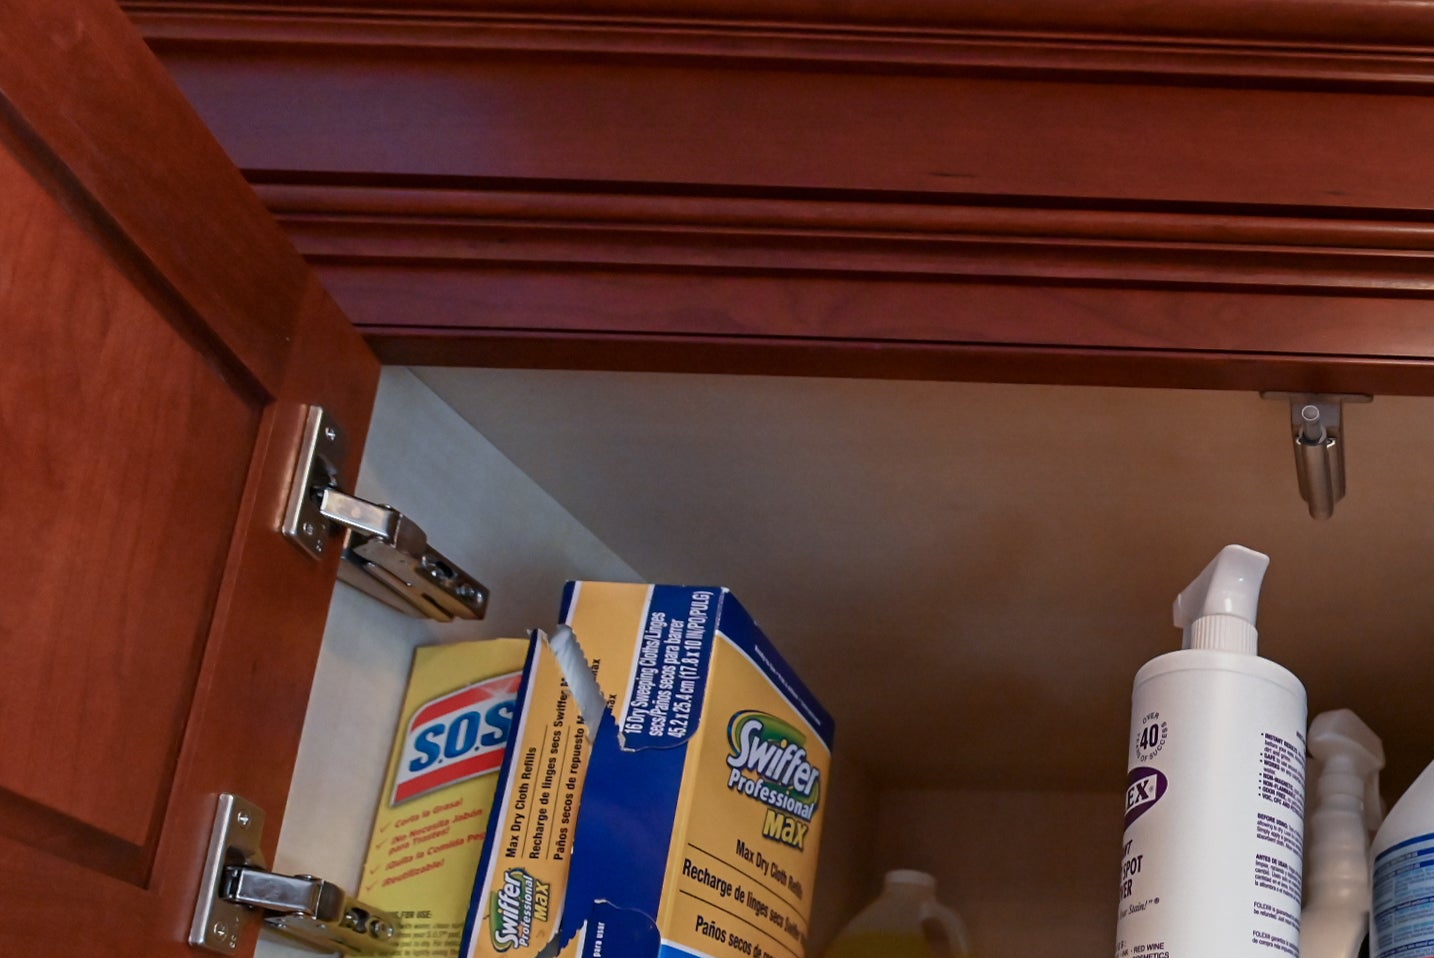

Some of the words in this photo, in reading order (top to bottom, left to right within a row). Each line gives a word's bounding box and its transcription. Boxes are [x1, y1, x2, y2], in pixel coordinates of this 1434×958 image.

[664, 618, 684, 644] barrer
[664, 644, 681, 664] para
[685, 640, 702, 651] 10
[660, 665, 677, 690] secos
[678, 657, 700, 679] (17.8
[630, 668, 658, 708] Sweeping
[680, 679, 695, 694] cm
[554, 689, 568, 727] Swiffer
[627, 707, 649, 722] Dry
[673, 693, 693, 713] 25.4
[624, 720, 643, 734] 16
[667, 719, 689, 738] 45.2
[1142, 711, 1159, 724] OVER
[550, 730, 562, 754] secs
[1140, 723, 1159, 750] 40
[521, 746, 537, 781] Refills
[570, 727, 585, 774] repuesto
[726, 719, 820, 797] Swiffer
[541, 757, 557, 789] linges
[565, 777, 577, 790] de
[515, 782, 530, 810] Cloth
[540, 791, 550, 805] de
[727, 767, 815, 821] Professional
[511, 811, 525, 832] Dry
[560, 793, 574, 824] secos
[529, 808, 547, 859] Recharge
[762, 808, 807, 850] Max
[505, 833, 520, 858] Max
[553, 827, 569, 860] Paños
[735, 839, 754, 864] Max
[754, 851, 770, 877] Dry
[769, 860, 787, 888] Cloth
[1123, 854, 1143, 880] SPOT
[533, 881, 550, 922] Max
[682, 858, 733, 899] Recharge
[734, 882, 745, 903] de
[746, 890, 769, 924] linges
[769, 906, 784, 927] secs
[494, 871, 522, 949] Swiffer
[518, 875, 533, 947] Professional
[597, 921, 605, 939] usar
[695, 914, 726, 945] Paños
[728, 930, 752, 953] secos
[593, 940, 603, 958] para
[1133, 944, 1145, 953] RED
[1147, 942, 1165, 951] WINE
